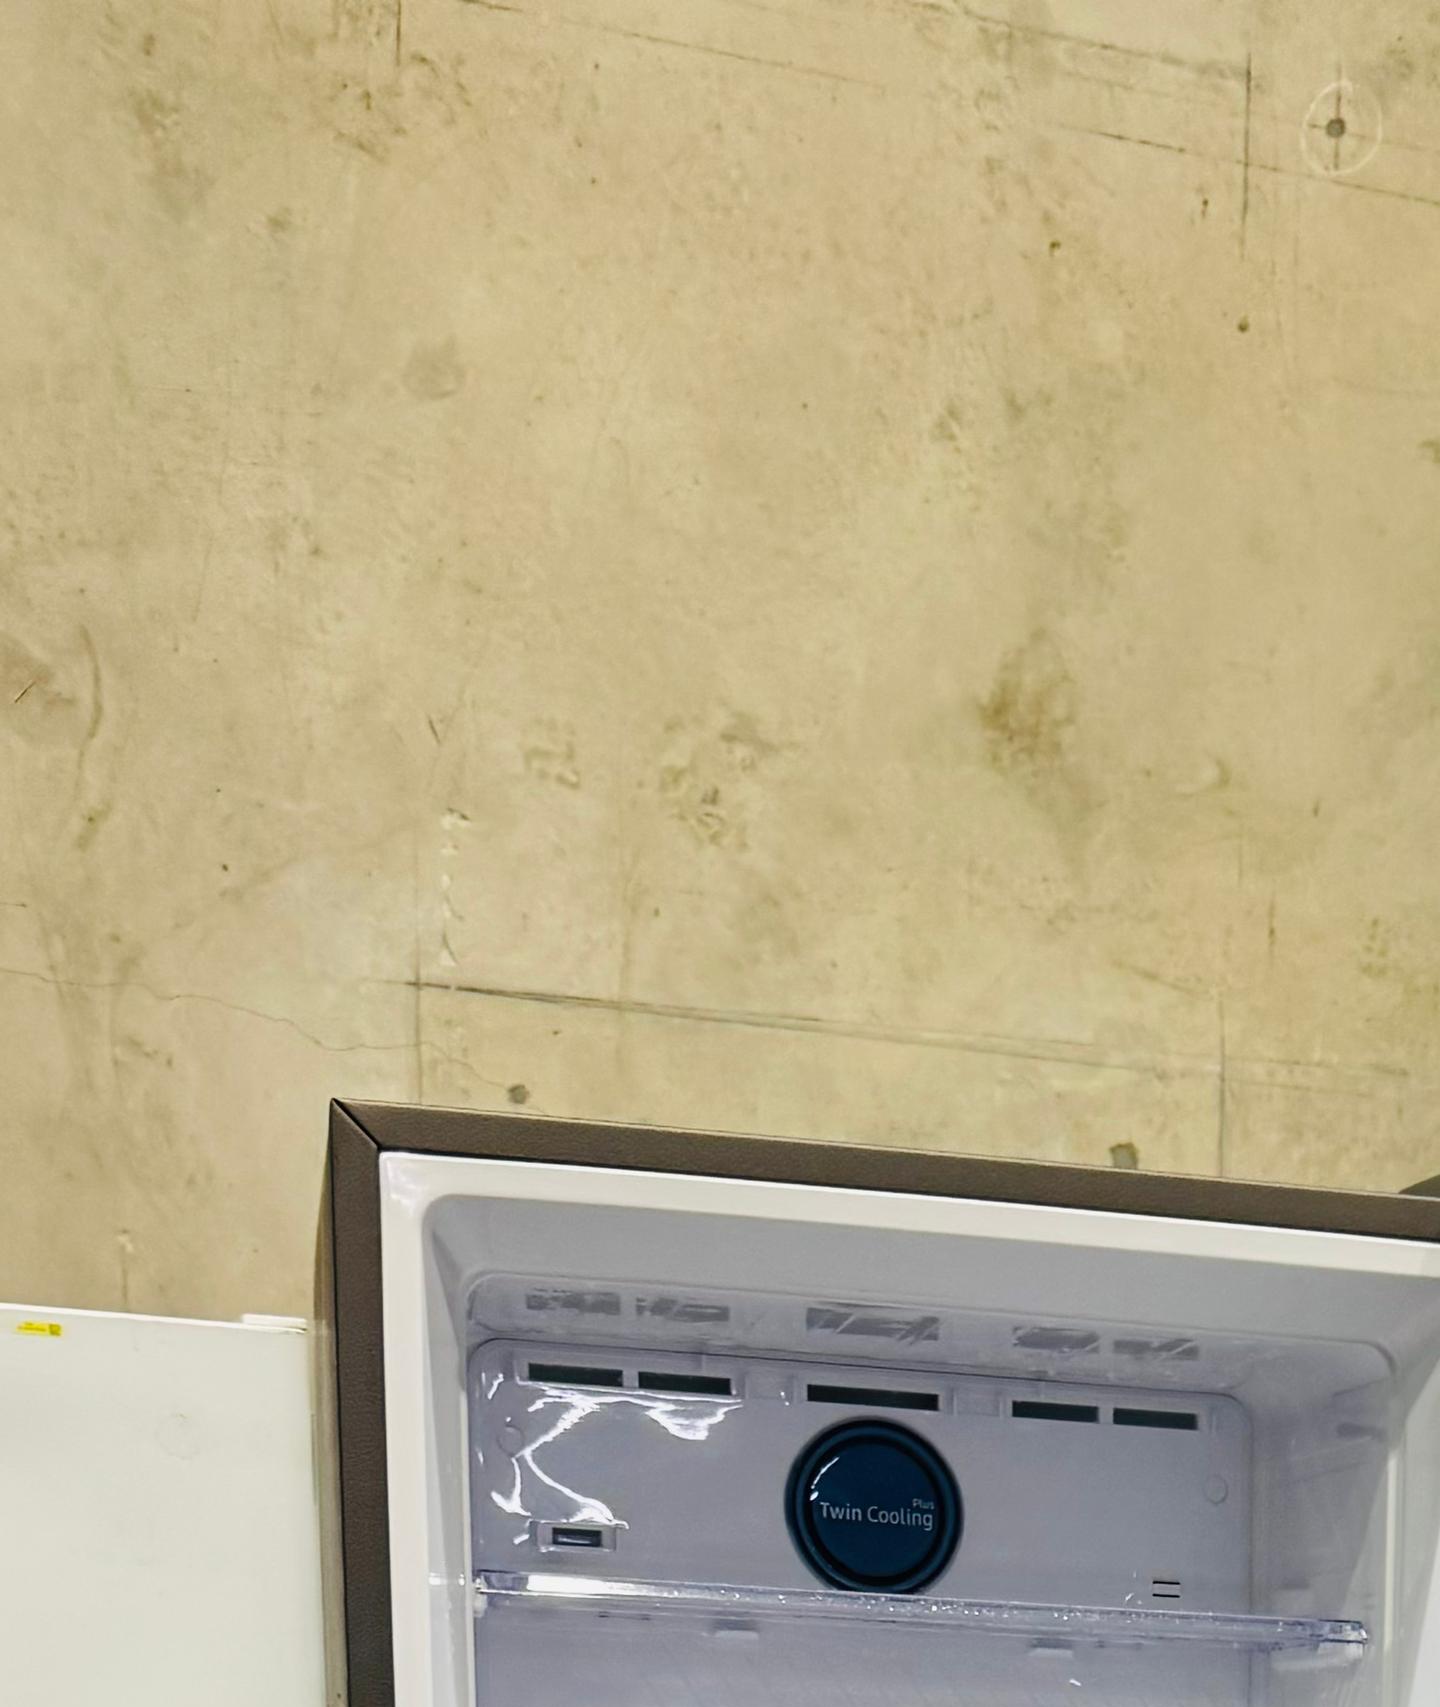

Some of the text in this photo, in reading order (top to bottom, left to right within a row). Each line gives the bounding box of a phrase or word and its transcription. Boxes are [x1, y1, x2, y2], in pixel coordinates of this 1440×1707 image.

[912, 1498, 935, 1510] Plus
[820, 1501, 933, 1531] Twin Cooling
